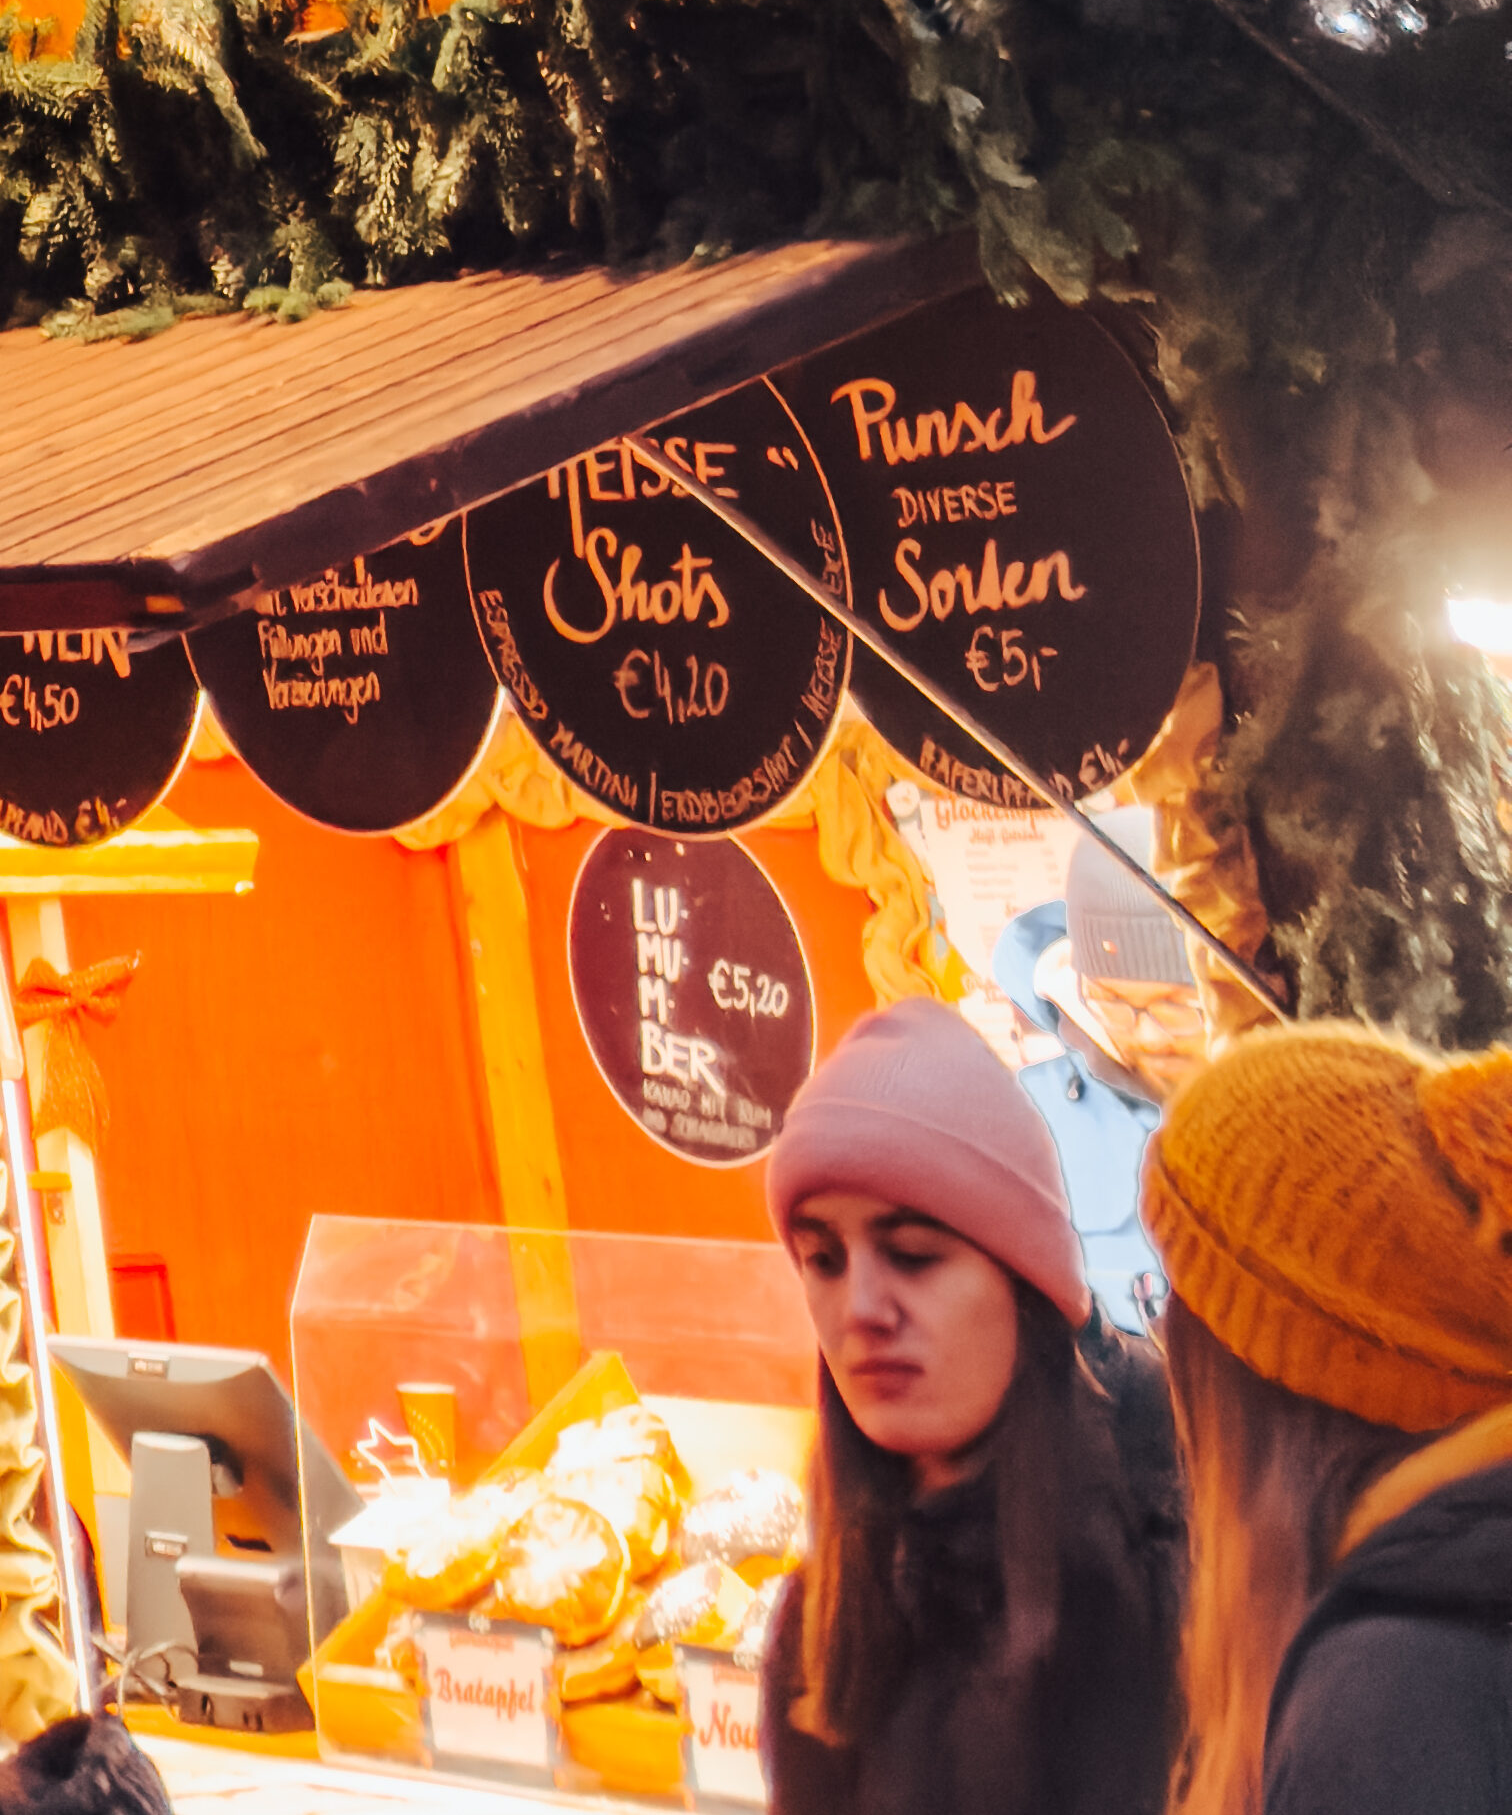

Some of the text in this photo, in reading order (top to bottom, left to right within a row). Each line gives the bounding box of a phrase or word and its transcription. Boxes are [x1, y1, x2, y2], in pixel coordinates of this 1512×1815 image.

[830, 369, 1078, 466] Punsch
[891, 480, 1018, 529] DIVERSE
[543, 526, 730, 644] Shots
[878, 538, 1089, 633] Sorten
[350, 610, 389, 657] und
[964, 624, 1059, 693] €5,-
[613, 648, 729, 725] €4,20
[707, 958, 790, 1018] €5,20
[639, 1019, 727, 1098] BER
[434, 1667, 536, 1721] Bratapfel
